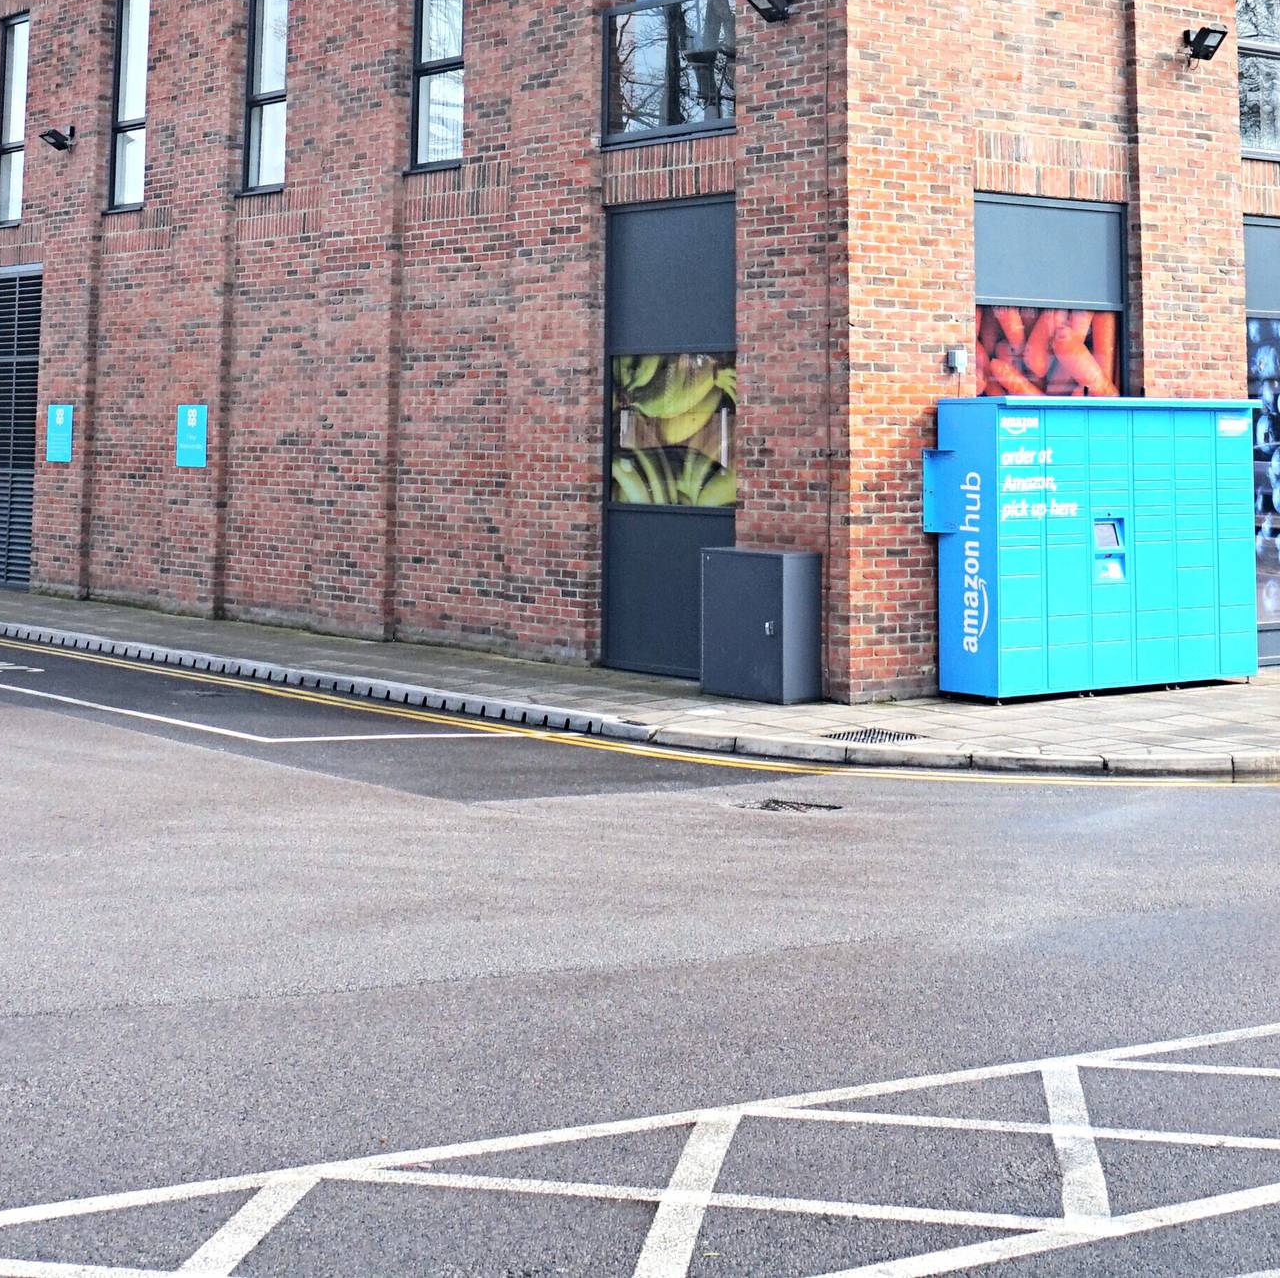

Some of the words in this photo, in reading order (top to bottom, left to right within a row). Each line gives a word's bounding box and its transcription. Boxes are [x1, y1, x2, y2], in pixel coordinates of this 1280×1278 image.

[1001, 447, 1037, 465] order
[1038, 448, 1053, 464] at
[1002, 474, 1056, 492] Amazon,
[960, 471, 981, 532] hub
[1002, 499, 1028, 521] pick
[1030, 502, 1047, 520] up
[1050, 498, 1078, 517] here
[963, 541, 986, 653] amazon
